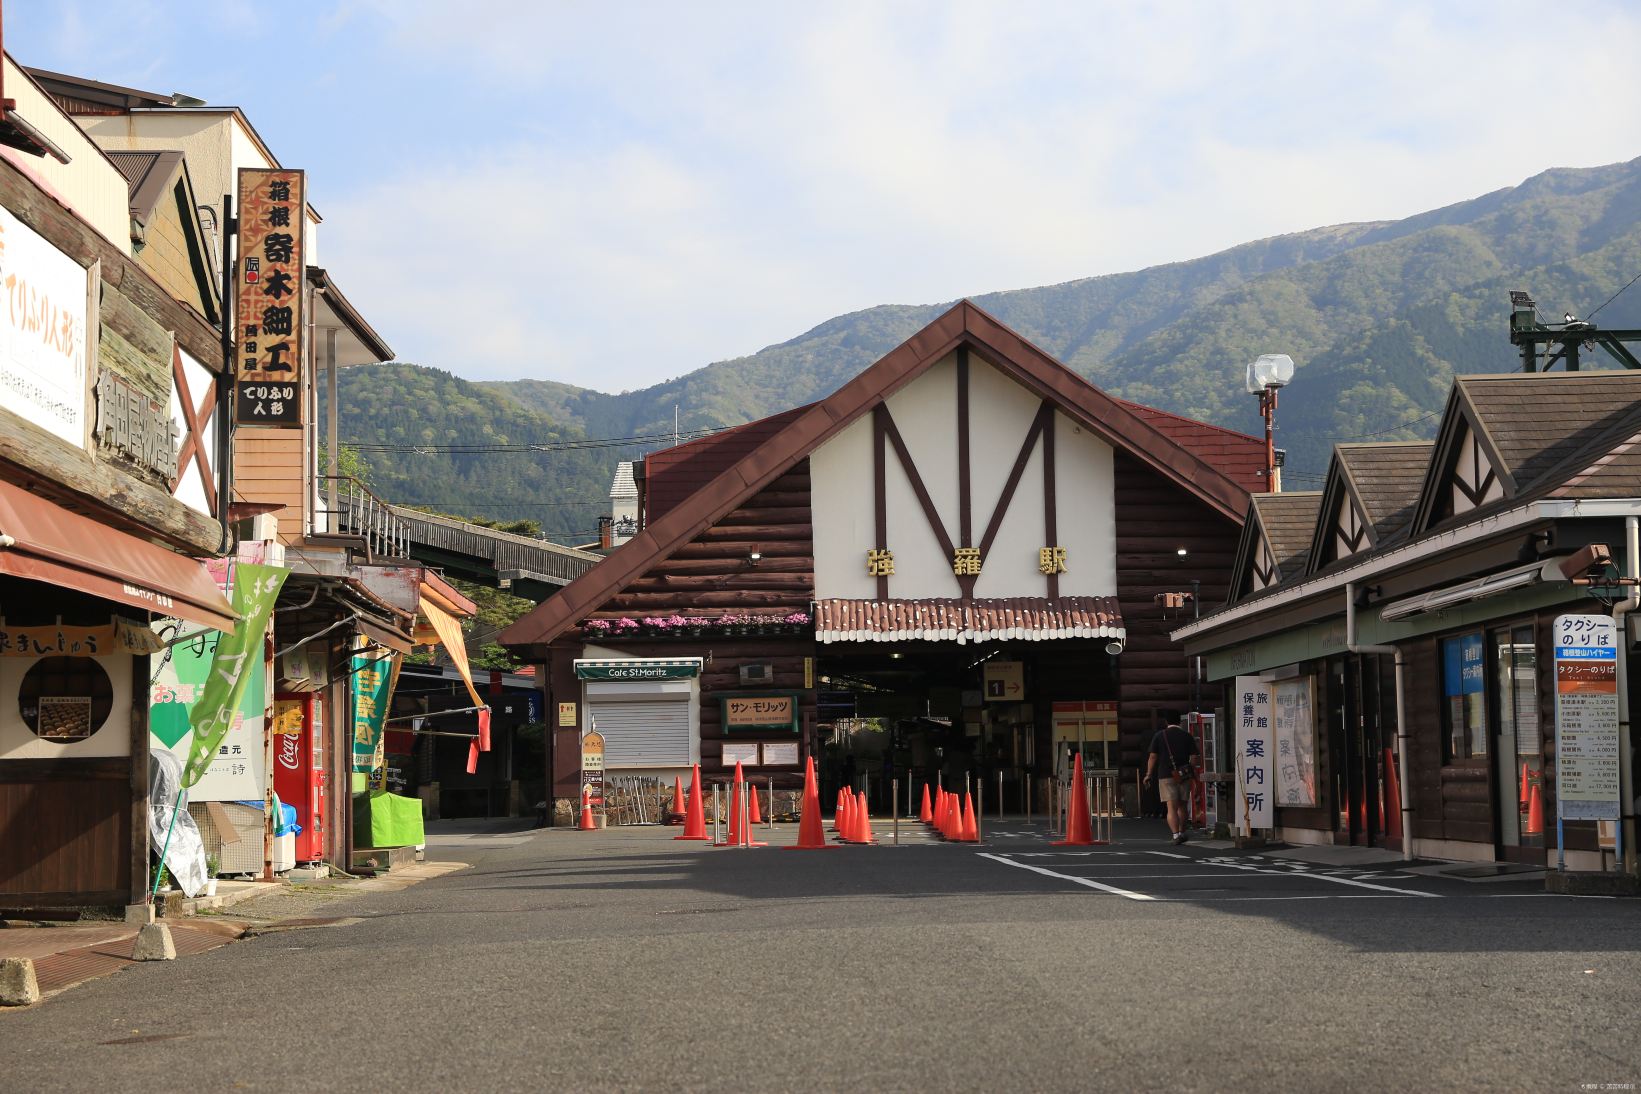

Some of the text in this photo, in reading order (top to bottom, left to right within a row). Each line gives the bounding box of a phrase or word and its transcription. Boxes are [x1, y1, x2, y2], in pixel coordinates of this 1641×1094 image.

[263, 181, 293, 372] 箱根寄木細工
[6, 272, 74, 357] てりふり人形
[243, 387, 293, 399] てりふり
[254, 402, 284, 415] 人形
[867, 547, 1067, 576] 強羅駅
[1562, 619, 1609, 631] タクシー
[1562, 634, 1609, 646] のりば
[731, 702, 788, 713] サン・モリッツ
[1243, 692, 1254, 728] 保養所
[1257, 692, 1268, 728] 旅館
[231, 763, 246, 775] 詩
[1246, 739, 1264, 811] 案内所
